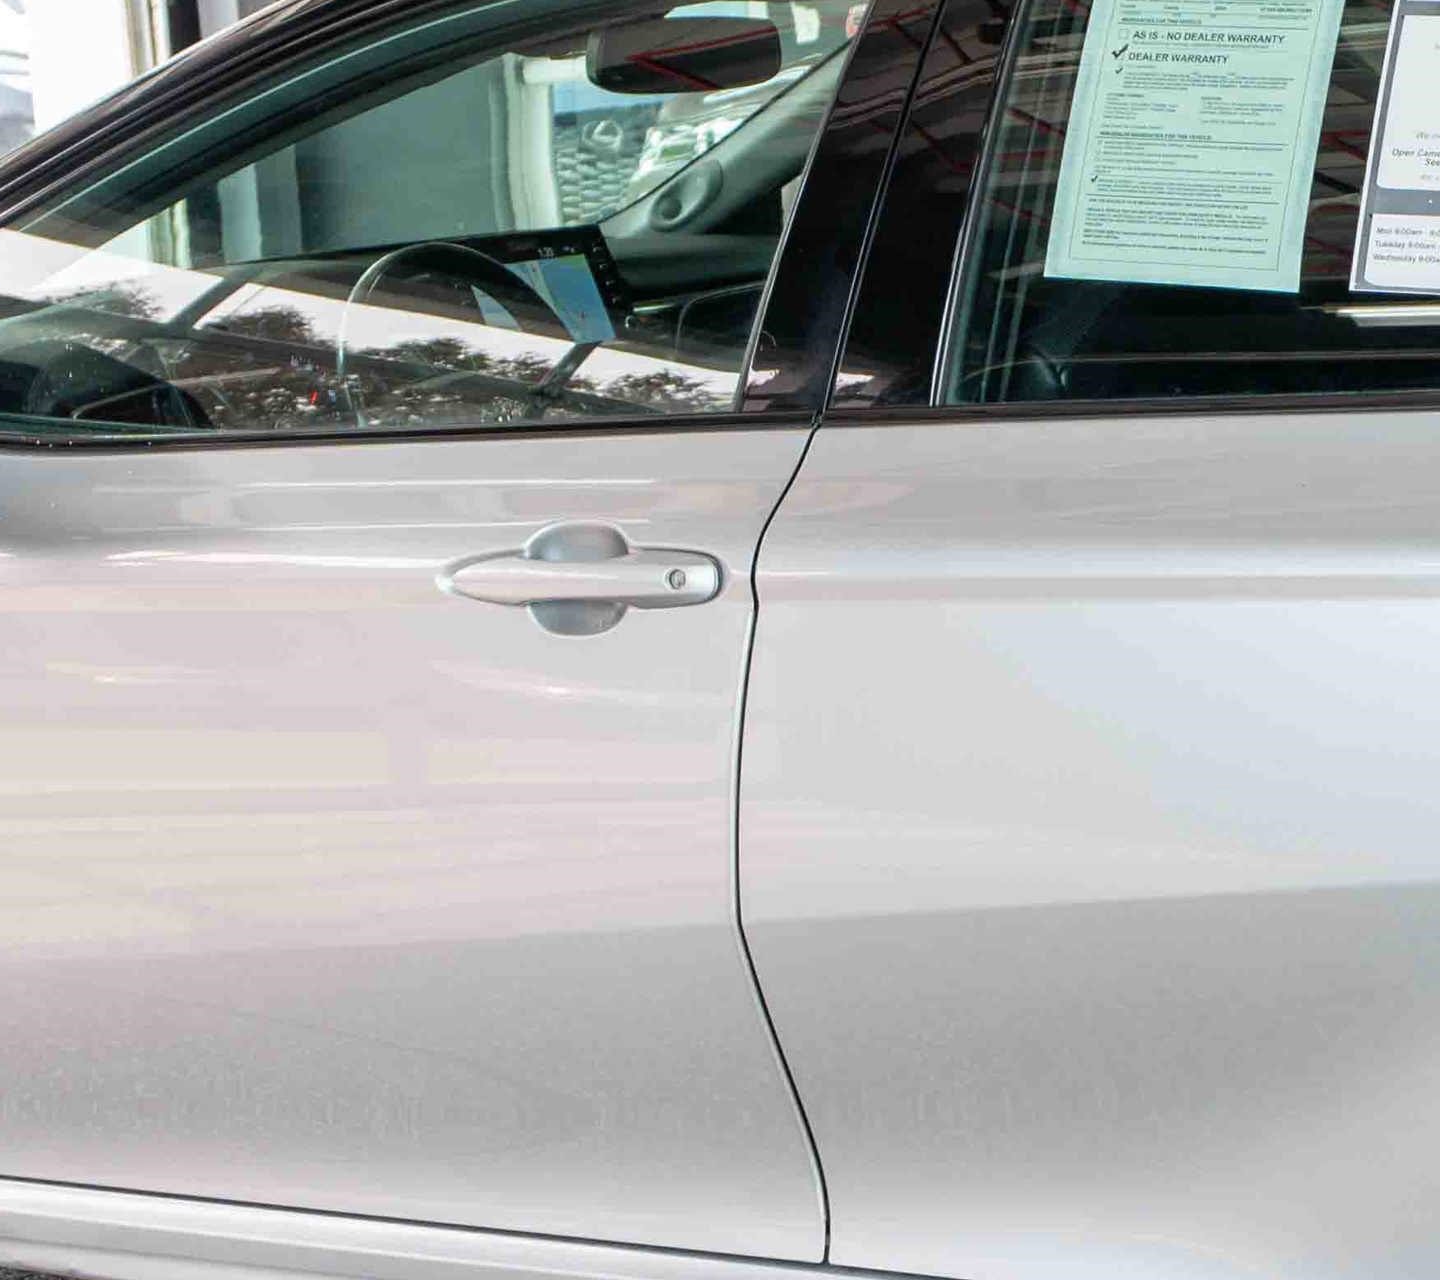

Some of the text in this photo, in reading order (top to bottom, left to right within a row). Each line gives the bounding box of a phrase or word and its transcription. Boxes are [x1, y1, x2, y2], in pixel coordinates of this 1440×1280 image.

[1133, 30, 1146, 39] AS
[1148, 31, 1159, 40] IS
[1167, 32, 1183, 41] NO
[1184, 32, 1224, 42] DEALER
[1227, 34, 1285, 44] WARRANTY
[1128, 52, 1229, 64] DEALER WARRANTY
